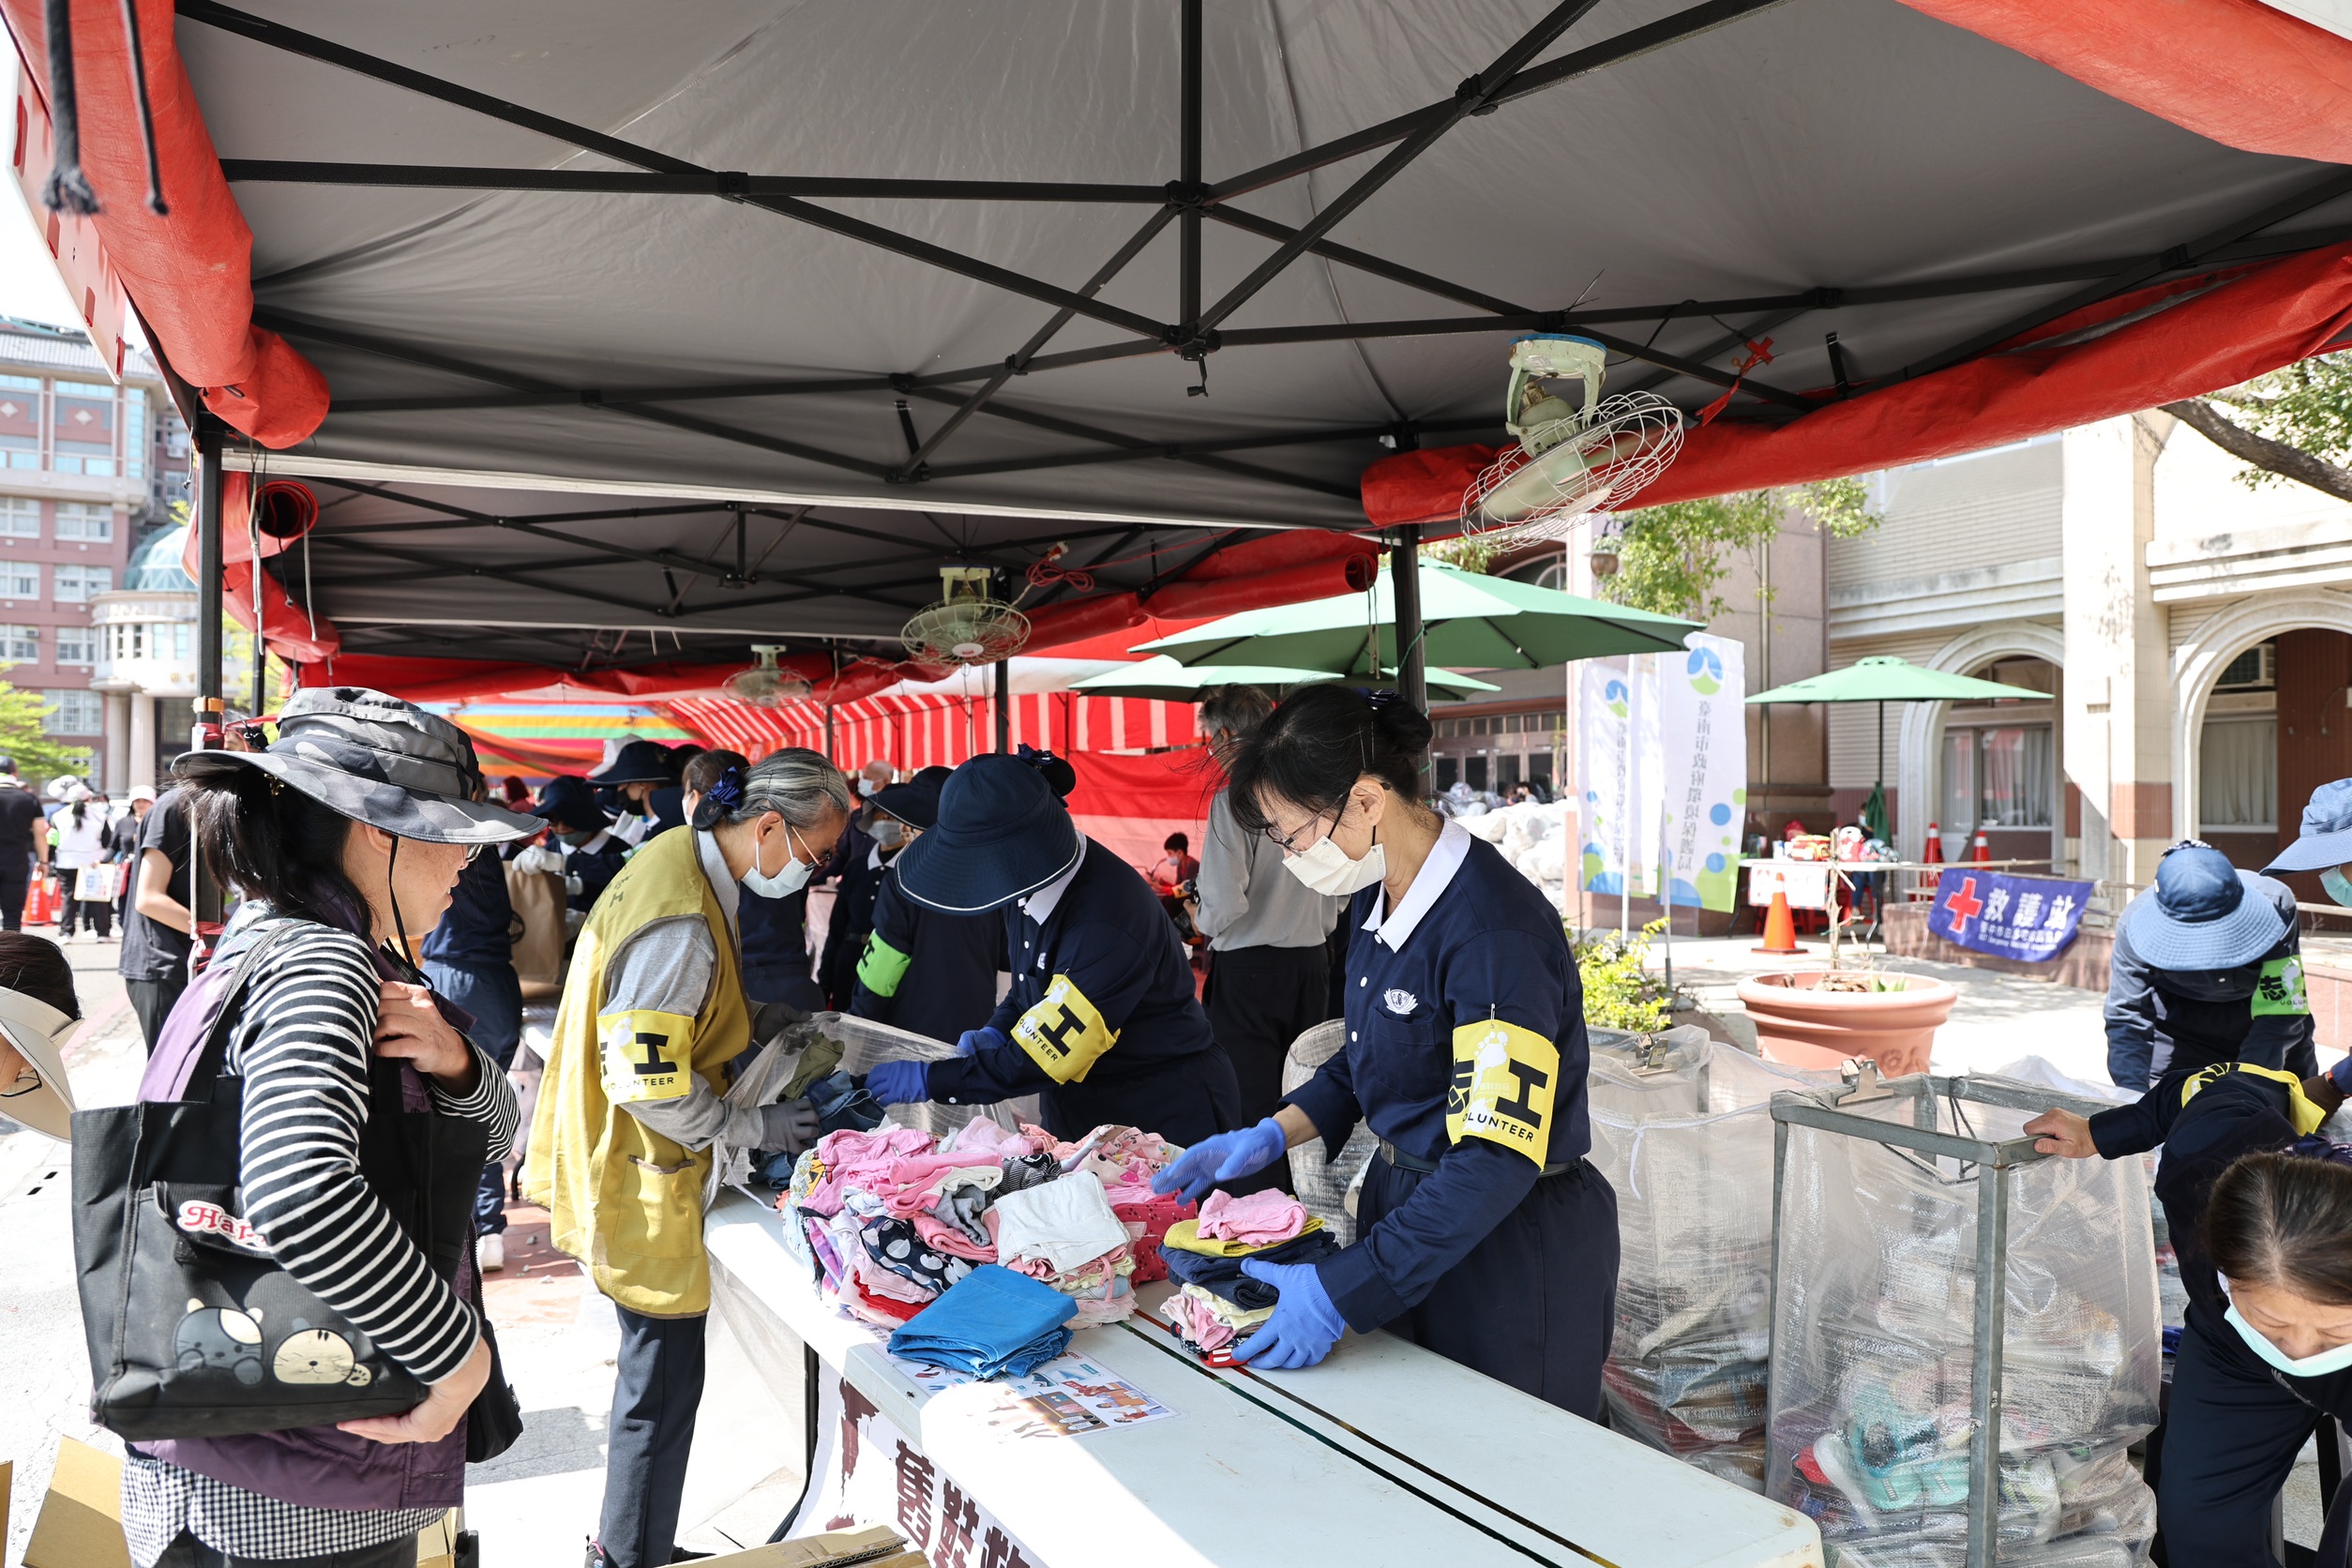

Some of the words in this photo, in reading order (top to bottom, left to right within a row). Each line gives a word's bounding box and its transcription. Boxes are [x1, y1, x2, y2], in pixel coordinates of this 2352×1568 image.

[1983, 887, 2075, 928] 救護站
[1018, 1018, 1058, 1062] OLUNTEER
[1461, 1111, 1534, 1142] OLUNTEER
[185, 1206, 265, 1243] Hap
